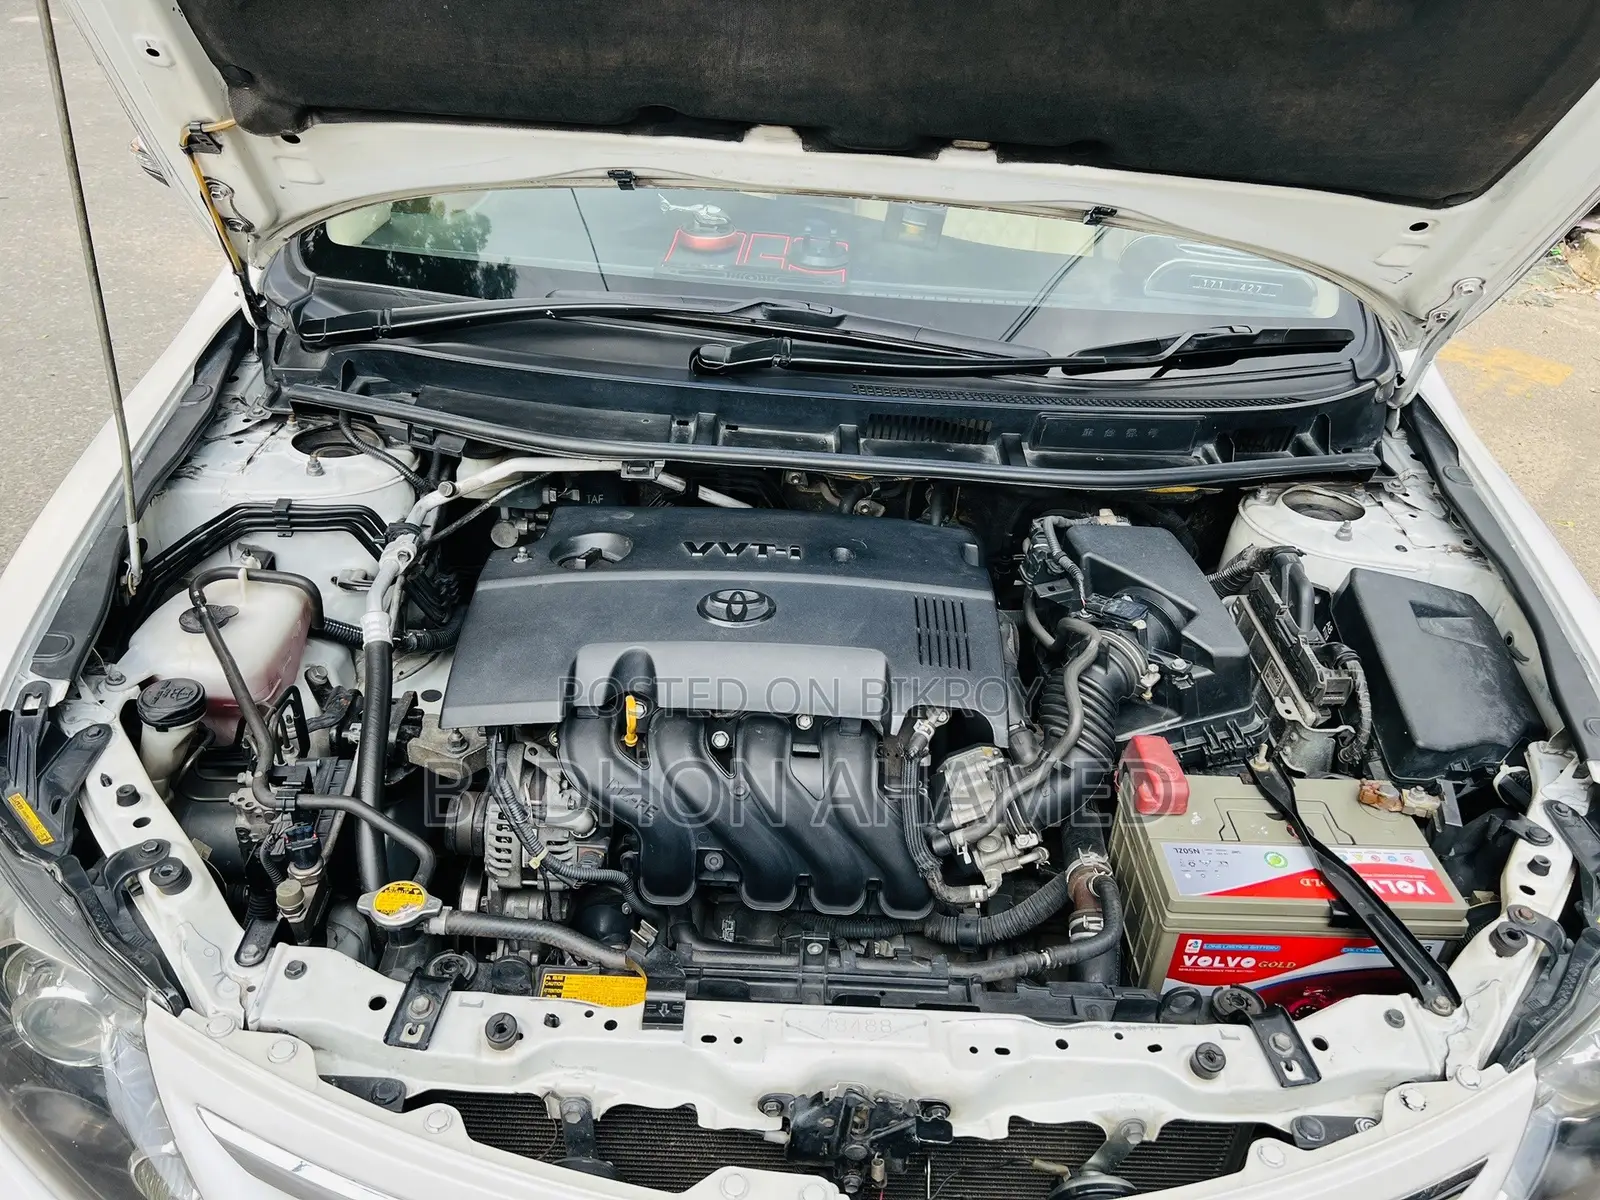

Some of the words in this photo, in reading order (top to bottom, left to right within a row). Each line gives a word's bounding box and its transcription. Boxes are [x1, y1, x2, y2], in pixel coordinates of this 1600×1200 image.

[1366, 880, 1436, 896] VOLV
[1183, 955, 1256, 968] VOLVO
[1258, 961, 1297, 969] GOLD
